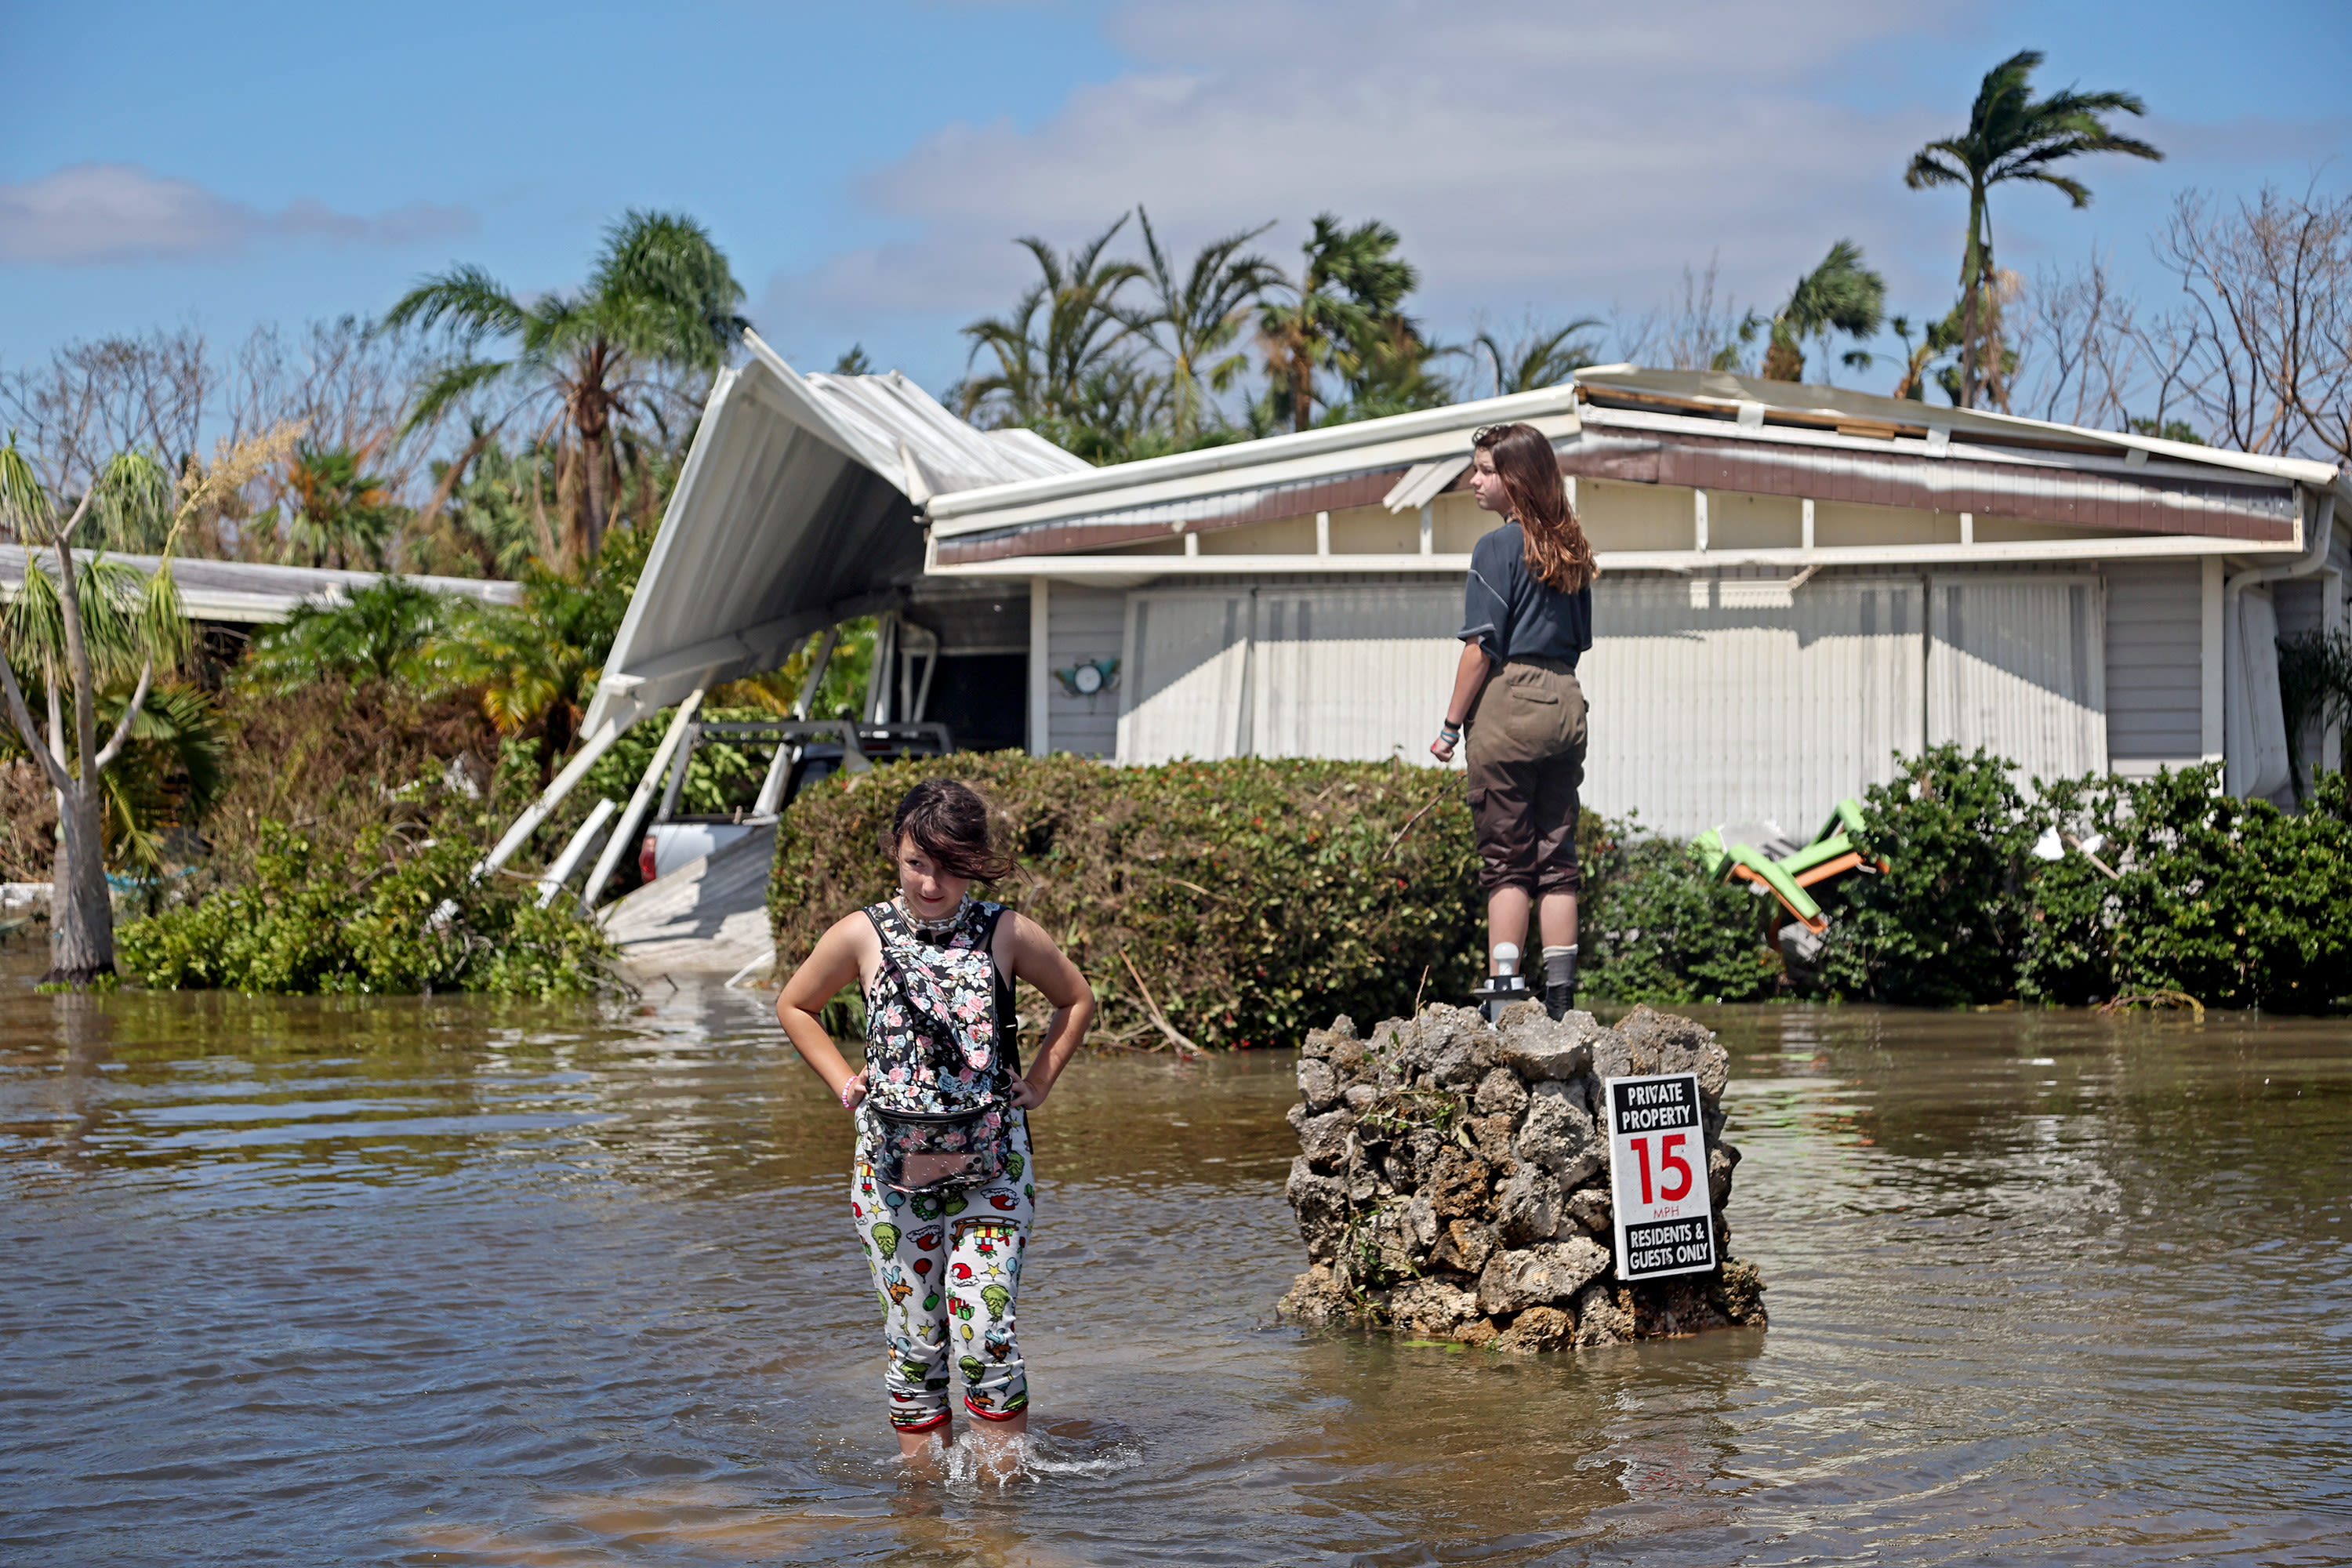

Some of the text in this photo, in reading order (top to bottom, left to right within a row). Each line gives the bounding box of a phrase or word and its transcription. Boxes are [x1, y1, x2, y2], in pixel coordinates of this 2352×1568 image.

[1627, 1082, 1683, 1106] PRIVATE
[1621, 1105, 1690, 1131] PROPERTY
[1630, 1133, 1693, 1205] 15
[1653, 1206, 1679, 1219] MPH
[1630, 1222, 1704, 1249] RESIDENTS &
[1629, 1243, 1708, 1270] GUESTS ONLY
